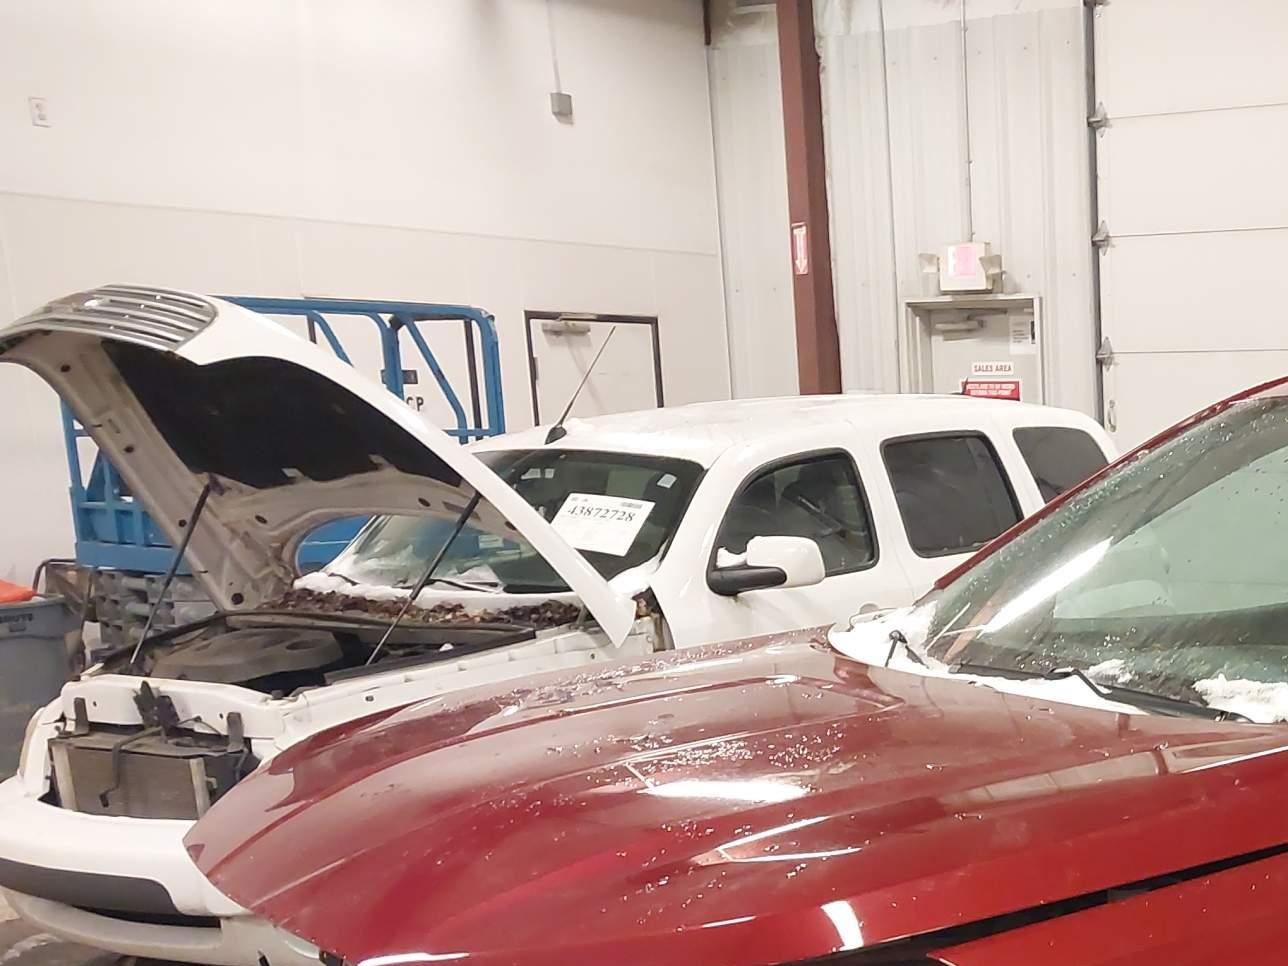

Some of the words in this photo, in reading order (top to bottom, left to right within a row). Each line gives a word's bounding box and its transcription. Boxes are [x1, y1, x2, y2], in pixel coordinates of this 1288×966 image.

[973, 364, 993, 373] SALES
[995, 364, 1012, 373] AREA
[567, 505, 636, 522] 43872728
